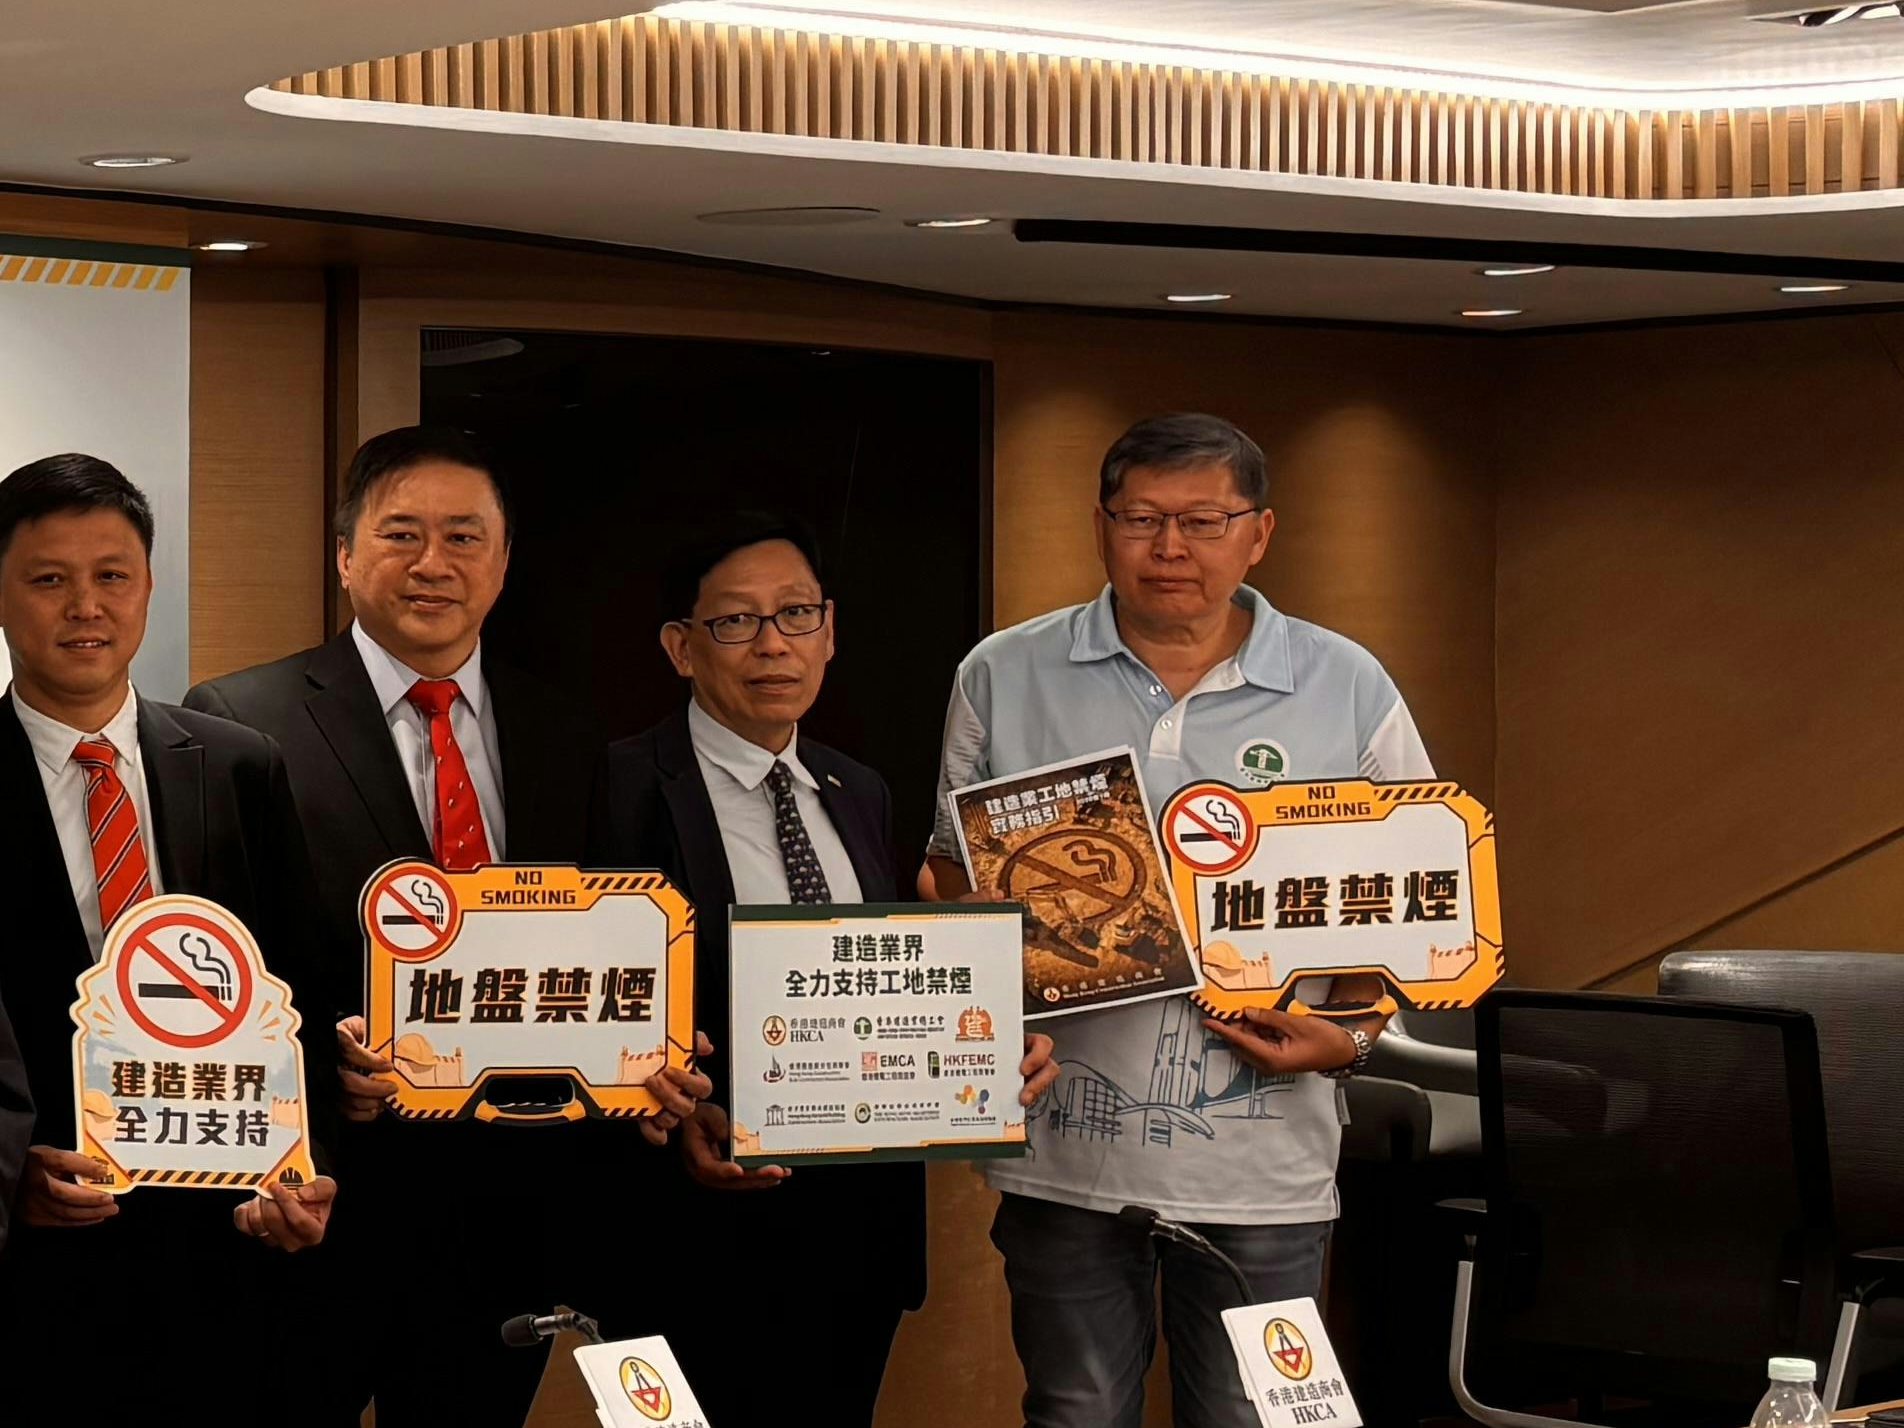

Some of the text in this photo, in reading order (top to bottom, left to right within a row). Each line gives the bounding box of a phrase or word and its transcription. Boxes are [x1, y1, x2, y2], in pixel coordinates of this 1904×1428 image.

[1307, 786, 1336, 800] NO
[1276, 802, 1371, 820] SMOKING
[514, 871, 543, 885] NO
[481, 889, 576, 905] SMOKING
[1210, 870, 1459, 933] 地盤禁煙
[832, 934, 925, 963] 建造業界
[785, 966, 972, 998] 全力支持工地禁煙
[405, 967, 657, 1024] 地盤禁煙
[790, 1030, 825, 1042] HKCA
[880, 1054, 916, 1068] EMCA
[943, 1053, 996, 1066] HKFEMC
[112, 1060, 267, 1102] 建造業界
[114, 1105, 270, 1148] 全力支持
[1265, 1377, 1345, 1409] 香港建造商會
[1290, 1402, 1338, 1425] HKCA
